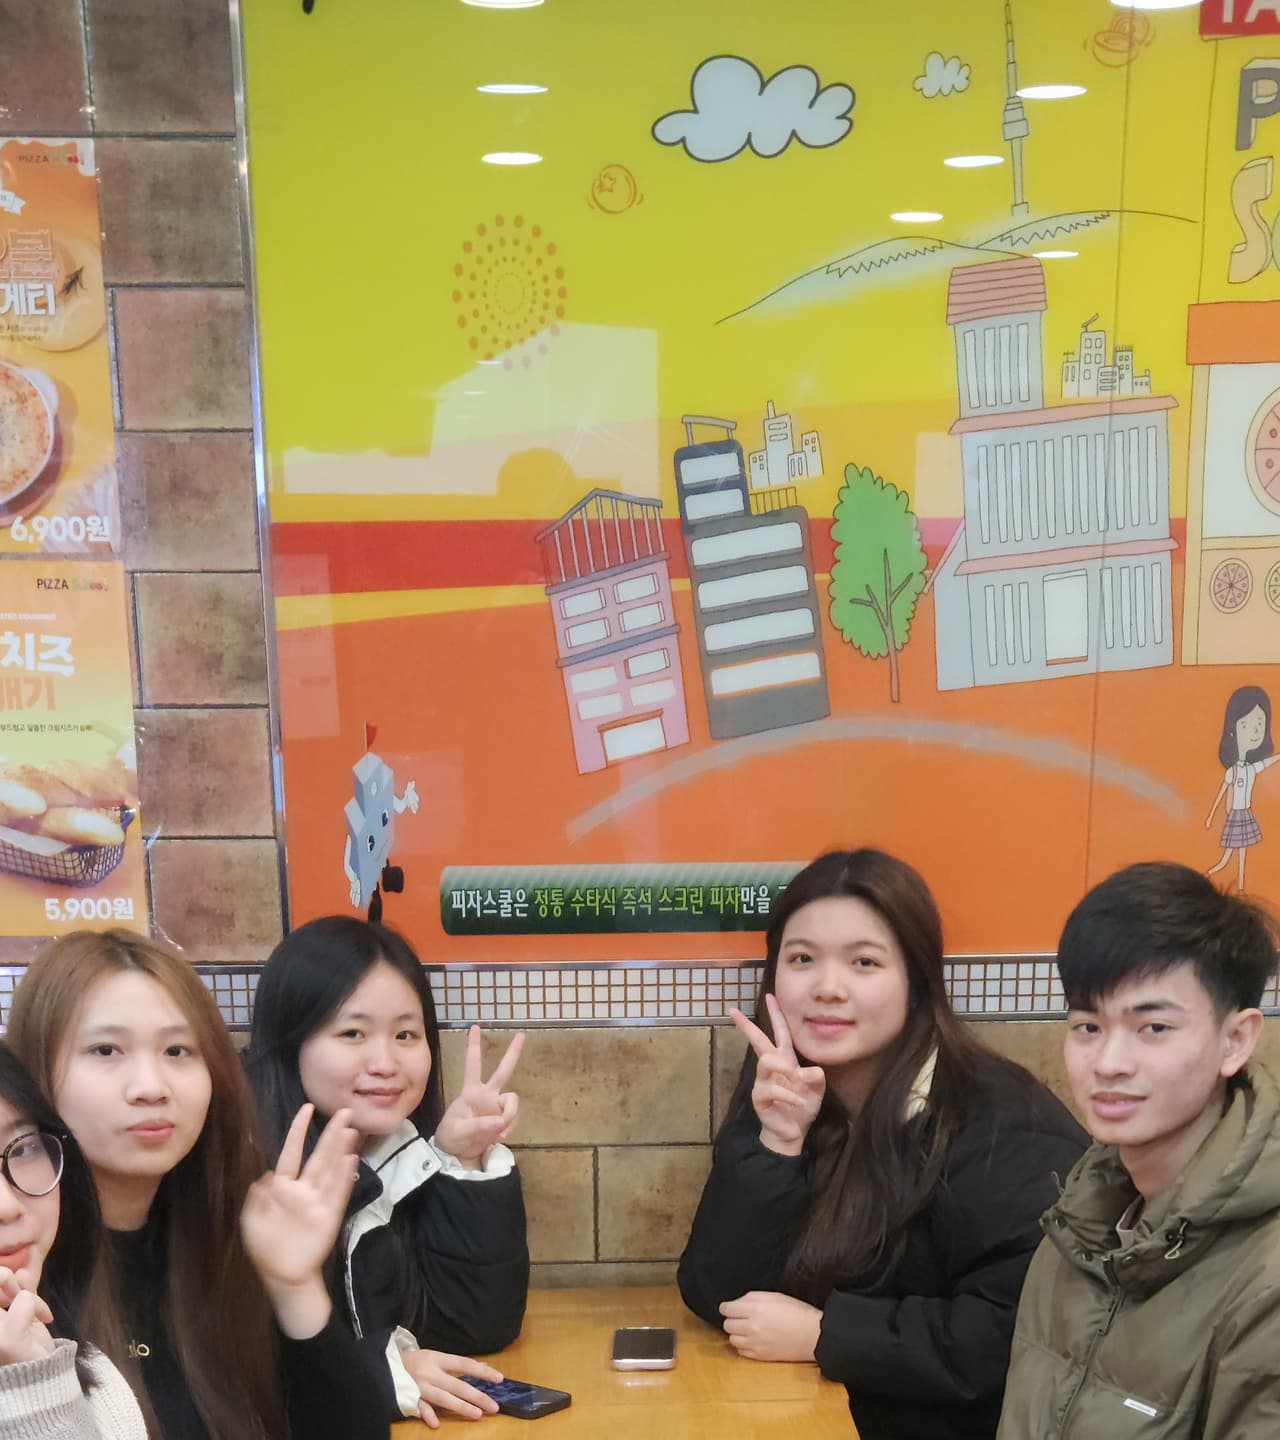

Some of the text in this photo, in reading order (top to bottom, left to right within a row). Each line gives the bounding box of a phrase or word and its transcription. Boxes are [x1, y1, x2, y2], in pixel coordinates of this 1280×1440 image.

[10, 514, 111, 543] 6,900원
[37, 578, 69, 590] PIZZA
[45, 898, 135, 922] 5,900원
[451, 885, 771, 918] 피자스쿨은 정통 수타식 즉석 스크린 피자만을
